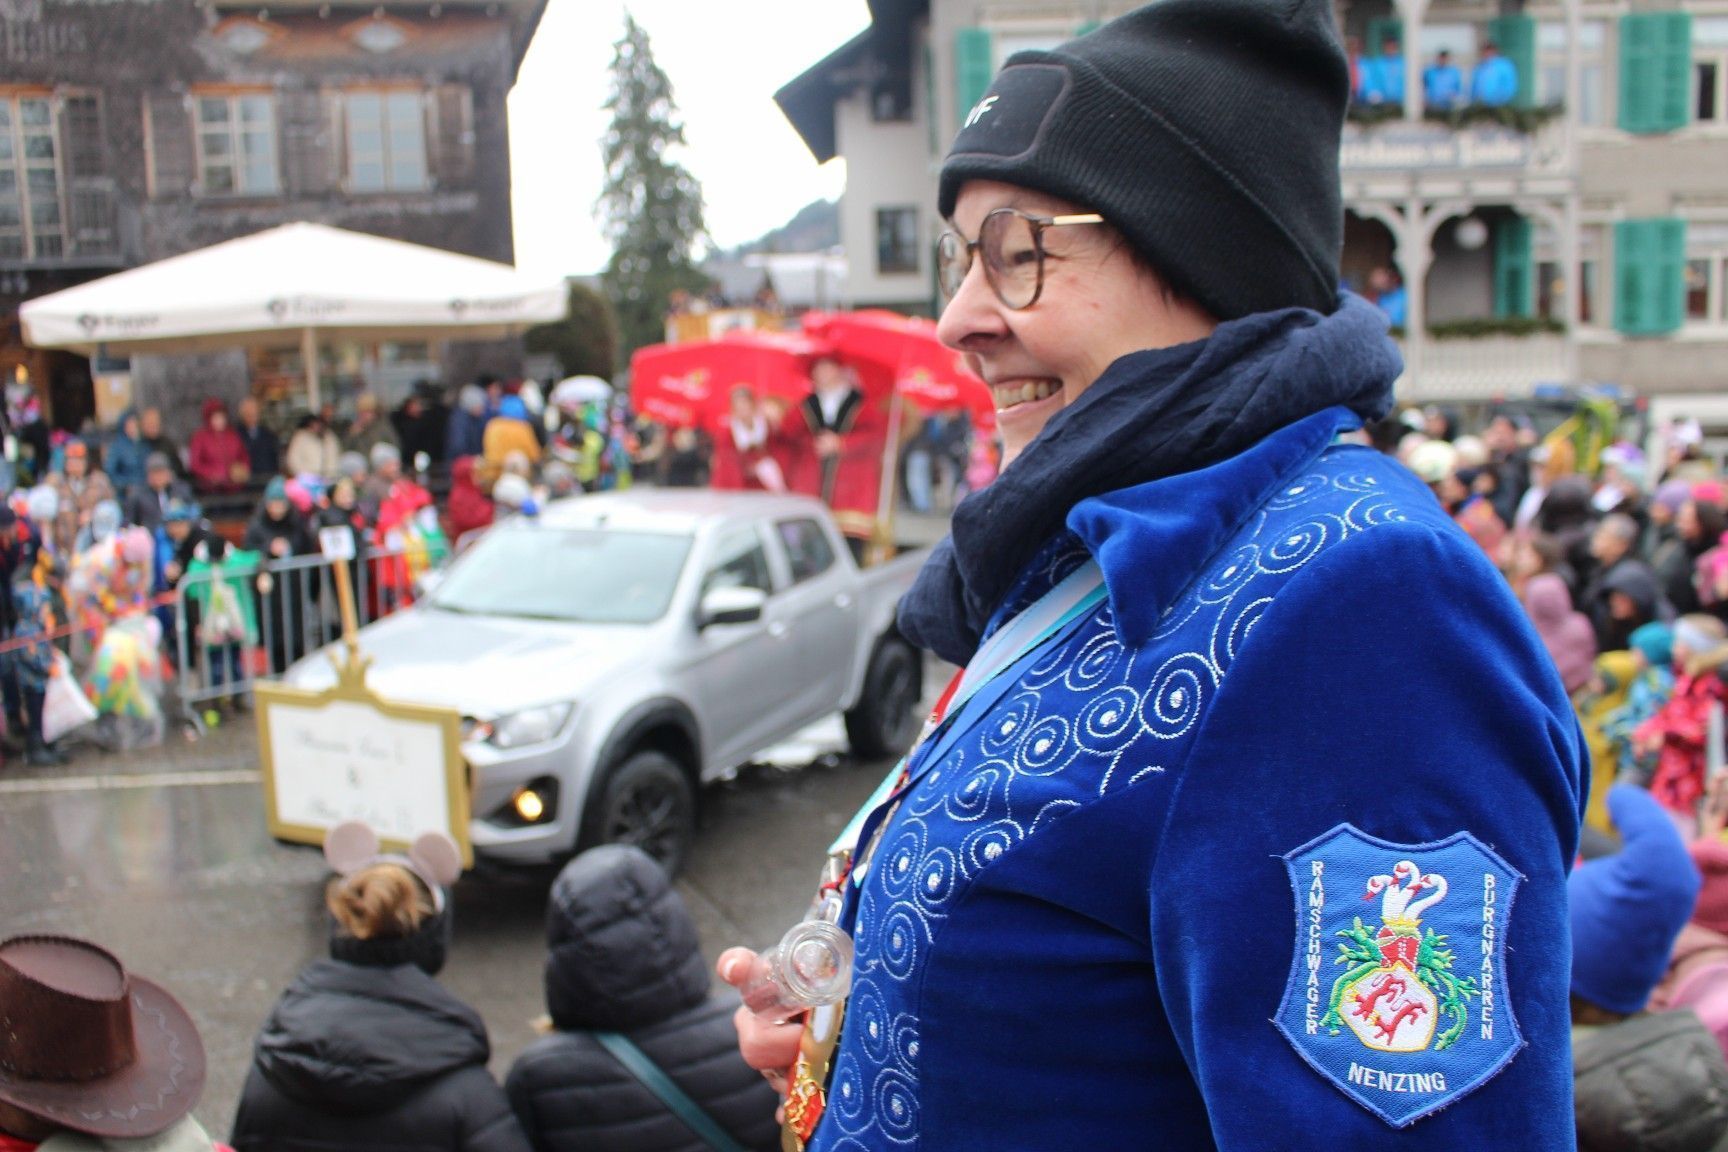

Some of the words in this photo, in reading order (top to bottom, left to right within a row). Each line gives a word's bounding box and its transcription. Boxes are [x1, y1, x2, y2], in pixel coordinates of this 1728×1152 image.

[1306, 861, 1324, 1035] RAMSCHWAGER
[1481, 874, 1496, 1039] BURGNARREN
[1348, 1063, 1447, 1092] NENZING
